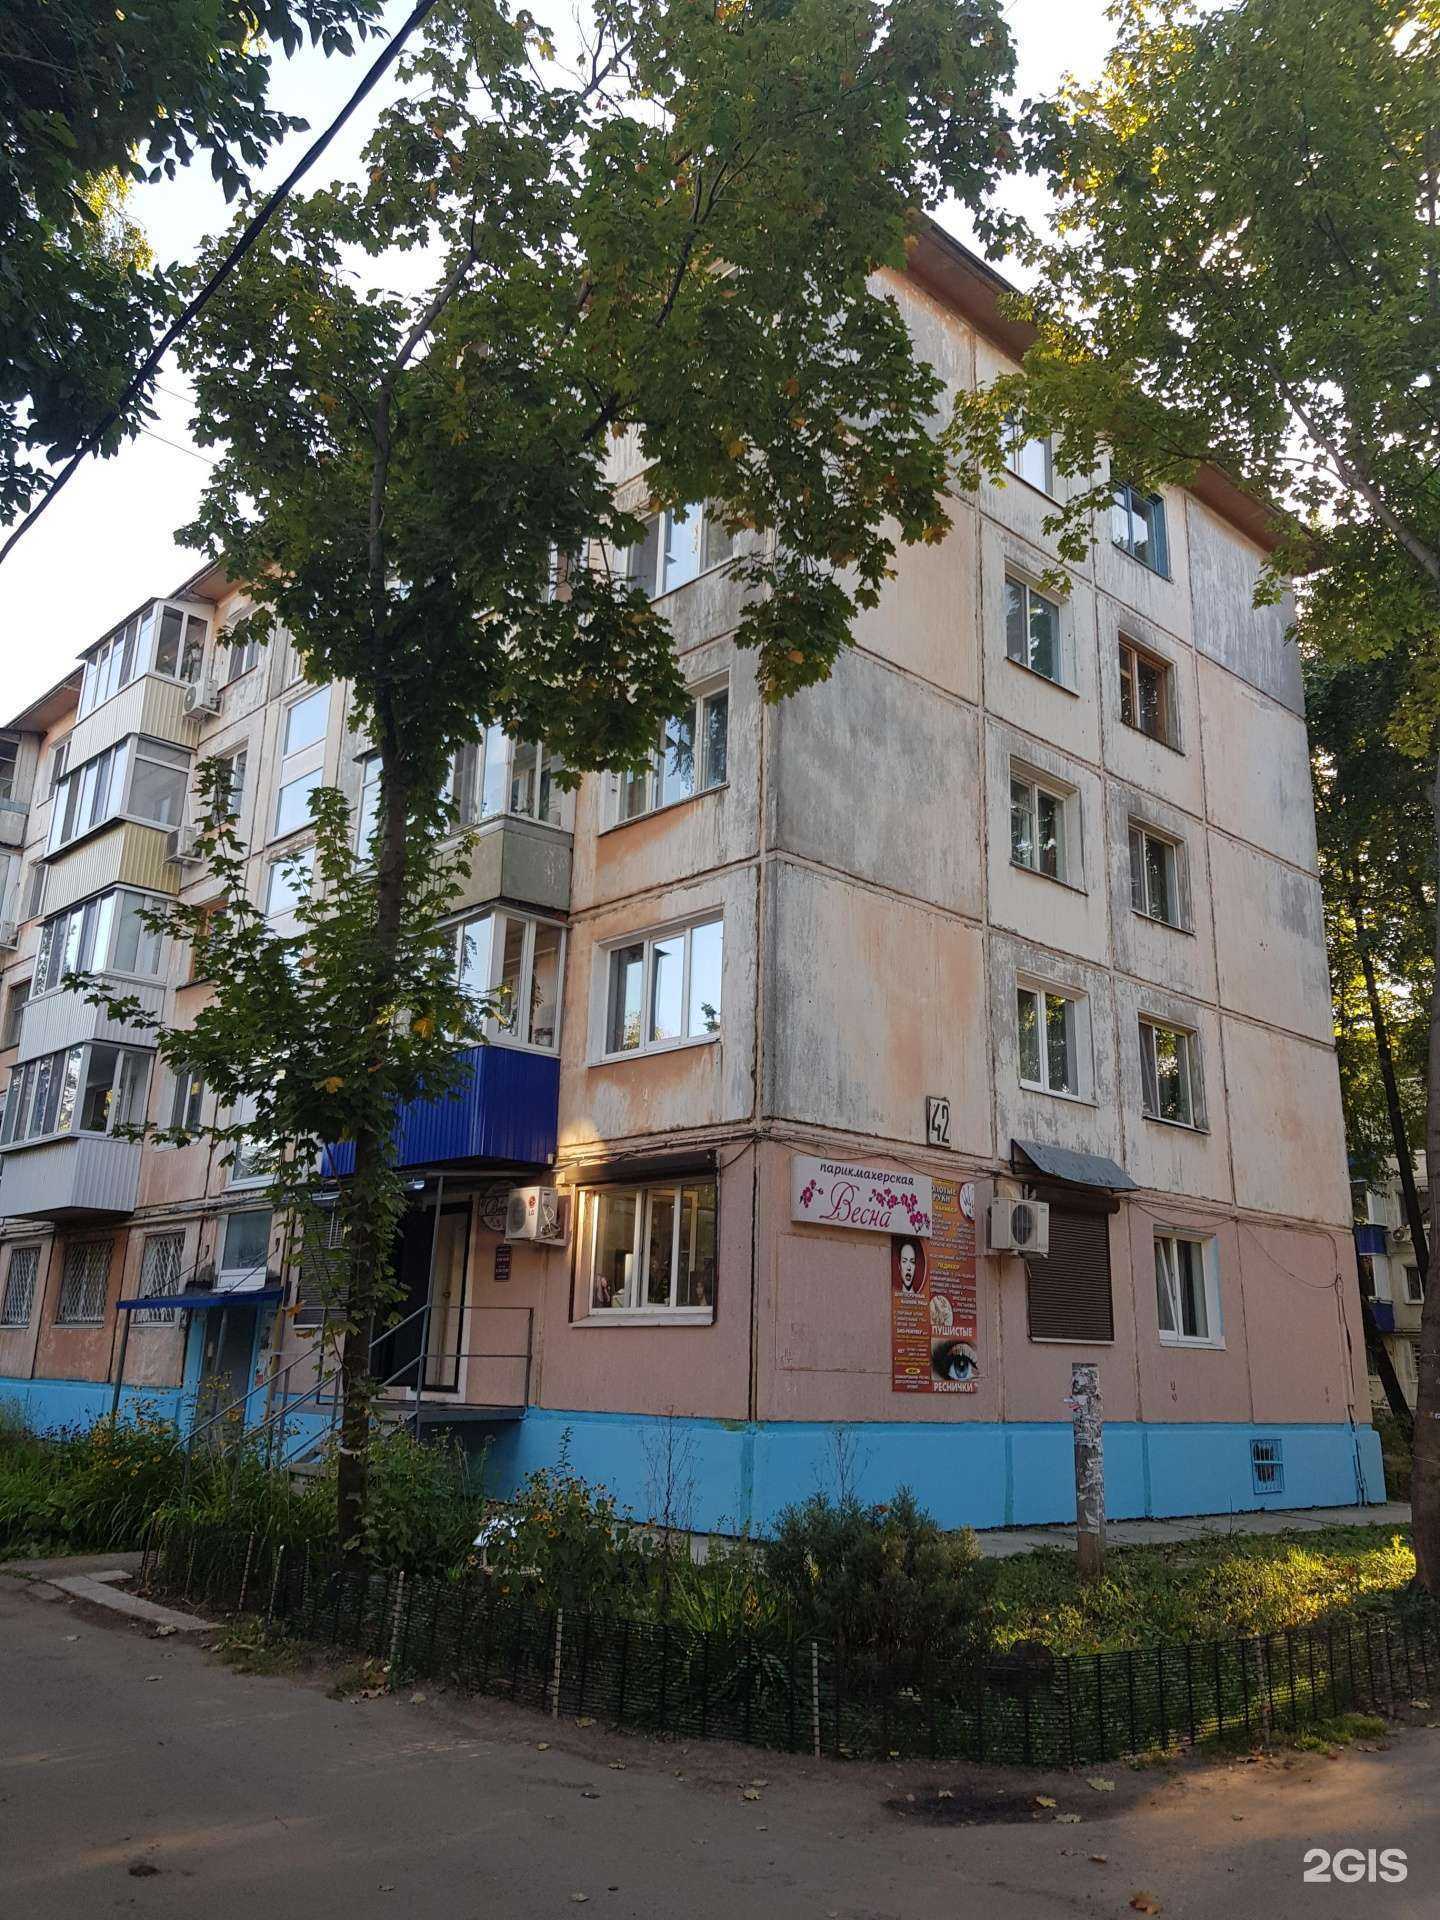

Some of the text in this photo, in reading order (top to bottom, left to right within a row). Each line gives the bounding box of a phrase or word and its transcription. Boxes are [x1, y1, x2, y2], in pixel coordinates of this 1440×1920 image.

[931, 1103, 950, 1144] 42
[819, 1162, 915, 1187] парикмахерская
[818, 1181, 892, 1229] Весна
[931, 1325, 973, 1338] ПУШИСТЫЕ
[933, 1381, 974, 1393] РЕСНИЧКИ
